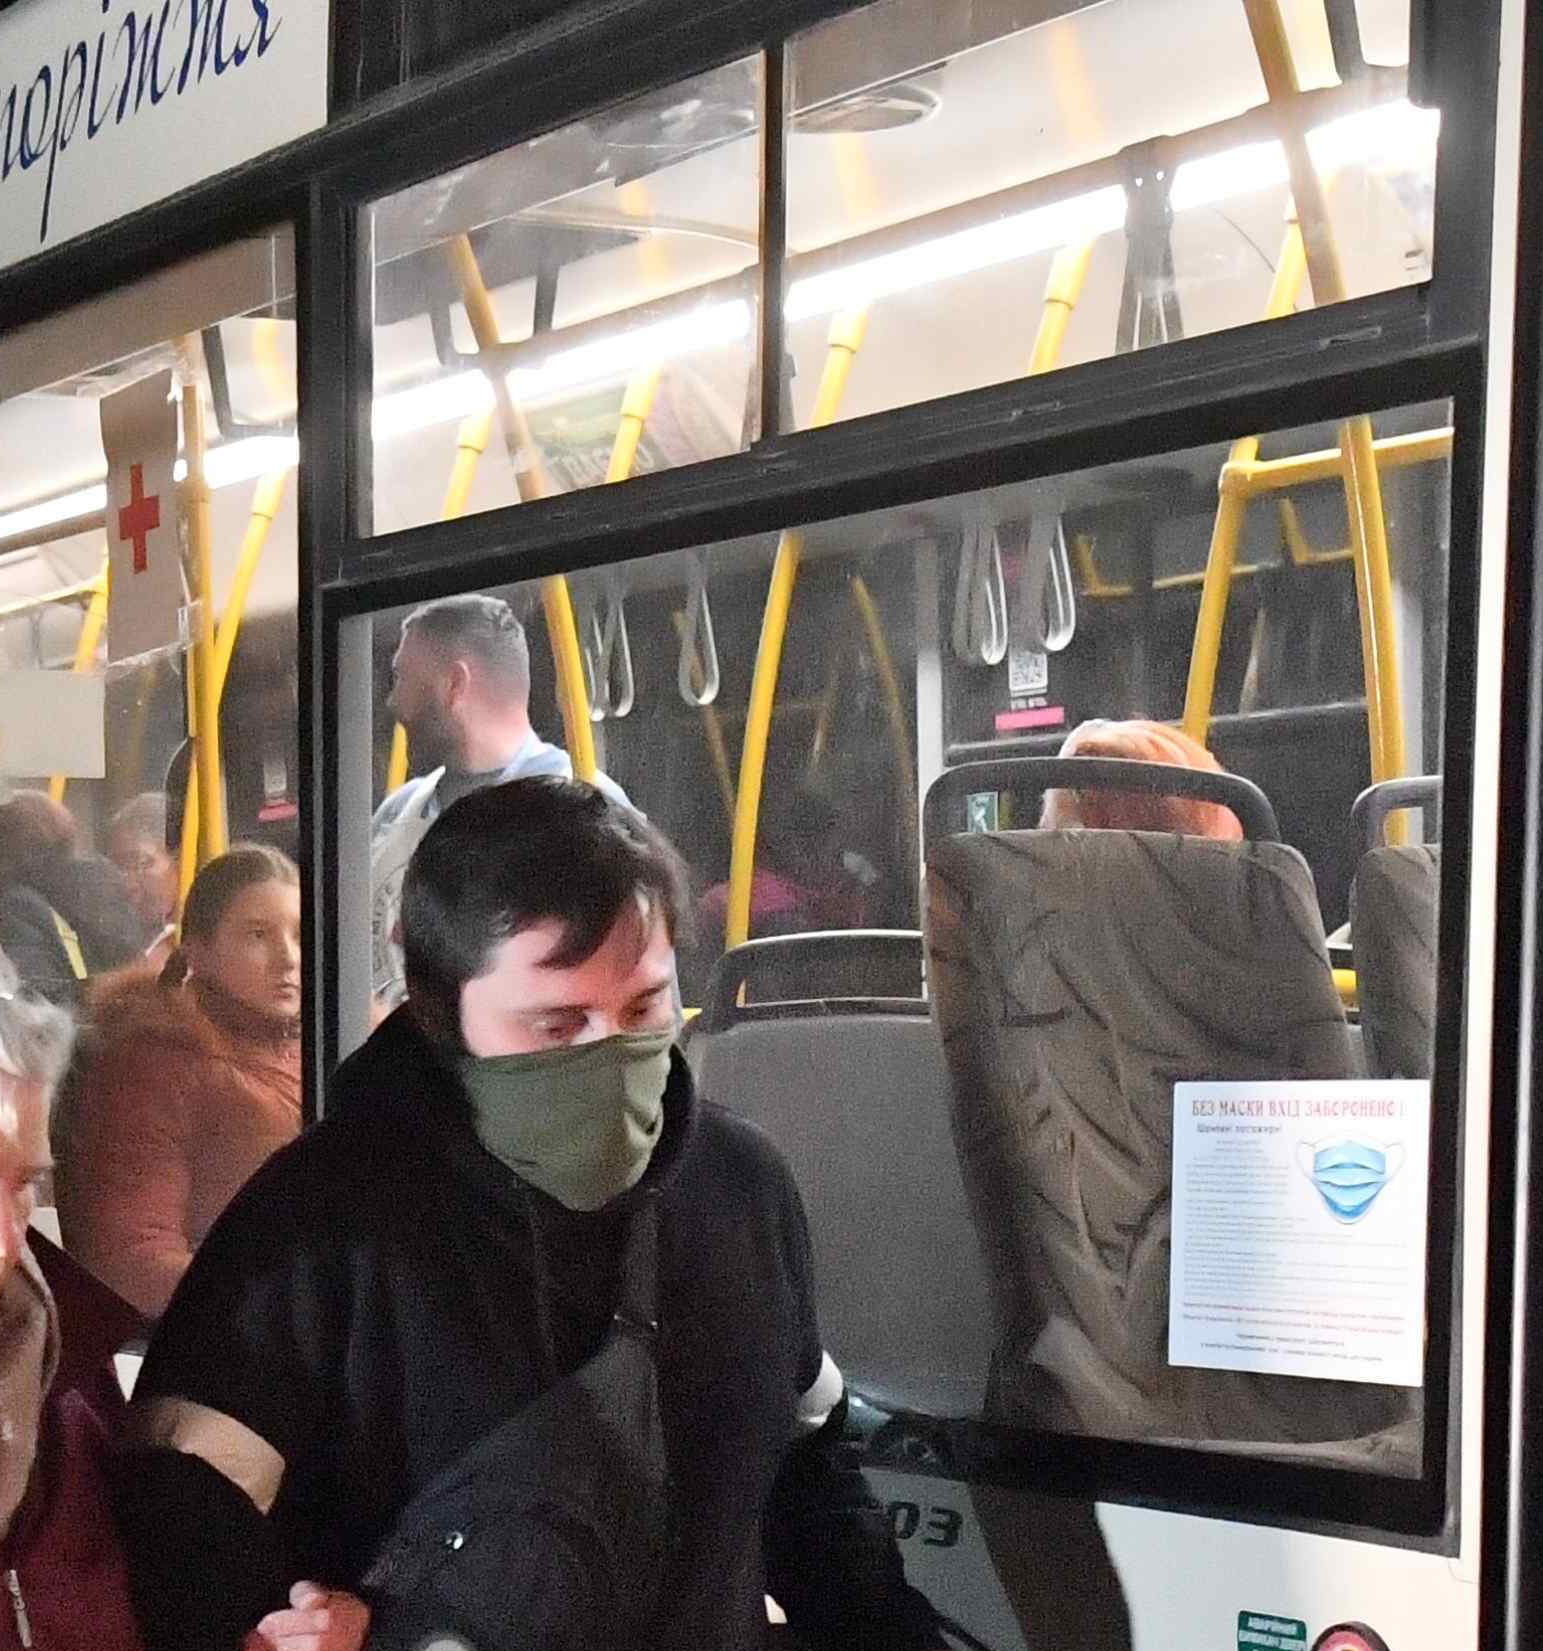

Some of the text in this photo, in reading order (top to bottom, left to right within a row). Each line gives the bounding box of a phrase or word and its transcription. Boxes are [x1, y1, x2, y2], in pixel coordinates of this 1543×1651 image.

[1191, 1099, 1215, 1117] БЕЗ
[1218, 1099, 1264, 1117] МАСКИ
[888, 1501, 964, 1548] 03
